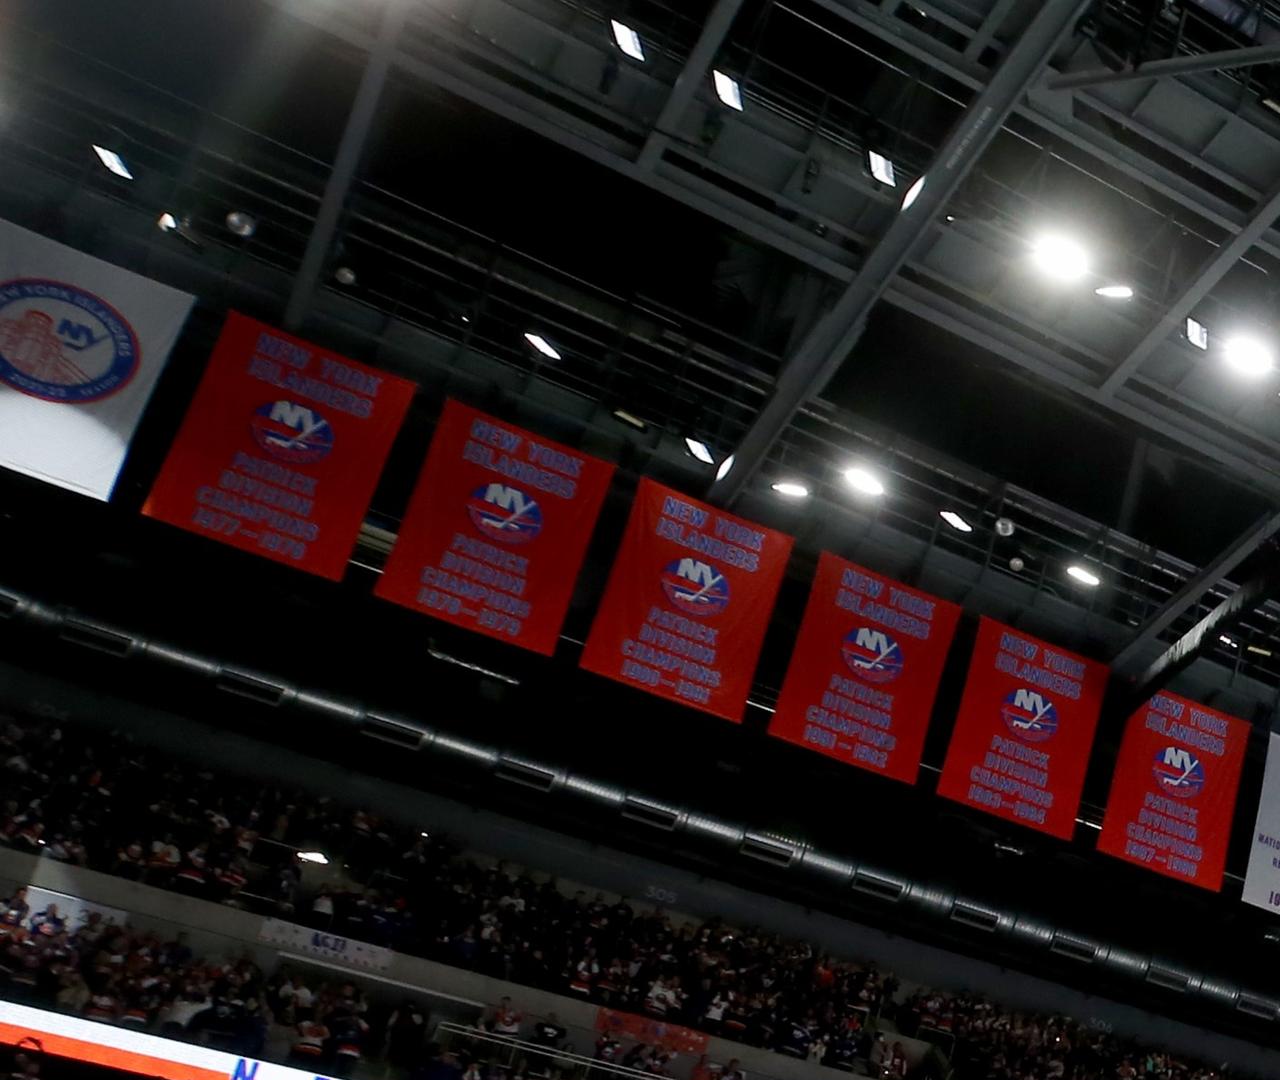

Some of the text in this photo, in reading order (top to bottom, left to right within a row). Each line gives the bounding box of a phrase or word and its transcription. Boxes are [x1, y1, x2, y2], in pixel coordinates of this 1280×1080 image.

[656, 517, 760, 573] ISLANDERS
[663, 496, 766, 551] NEW YORK
